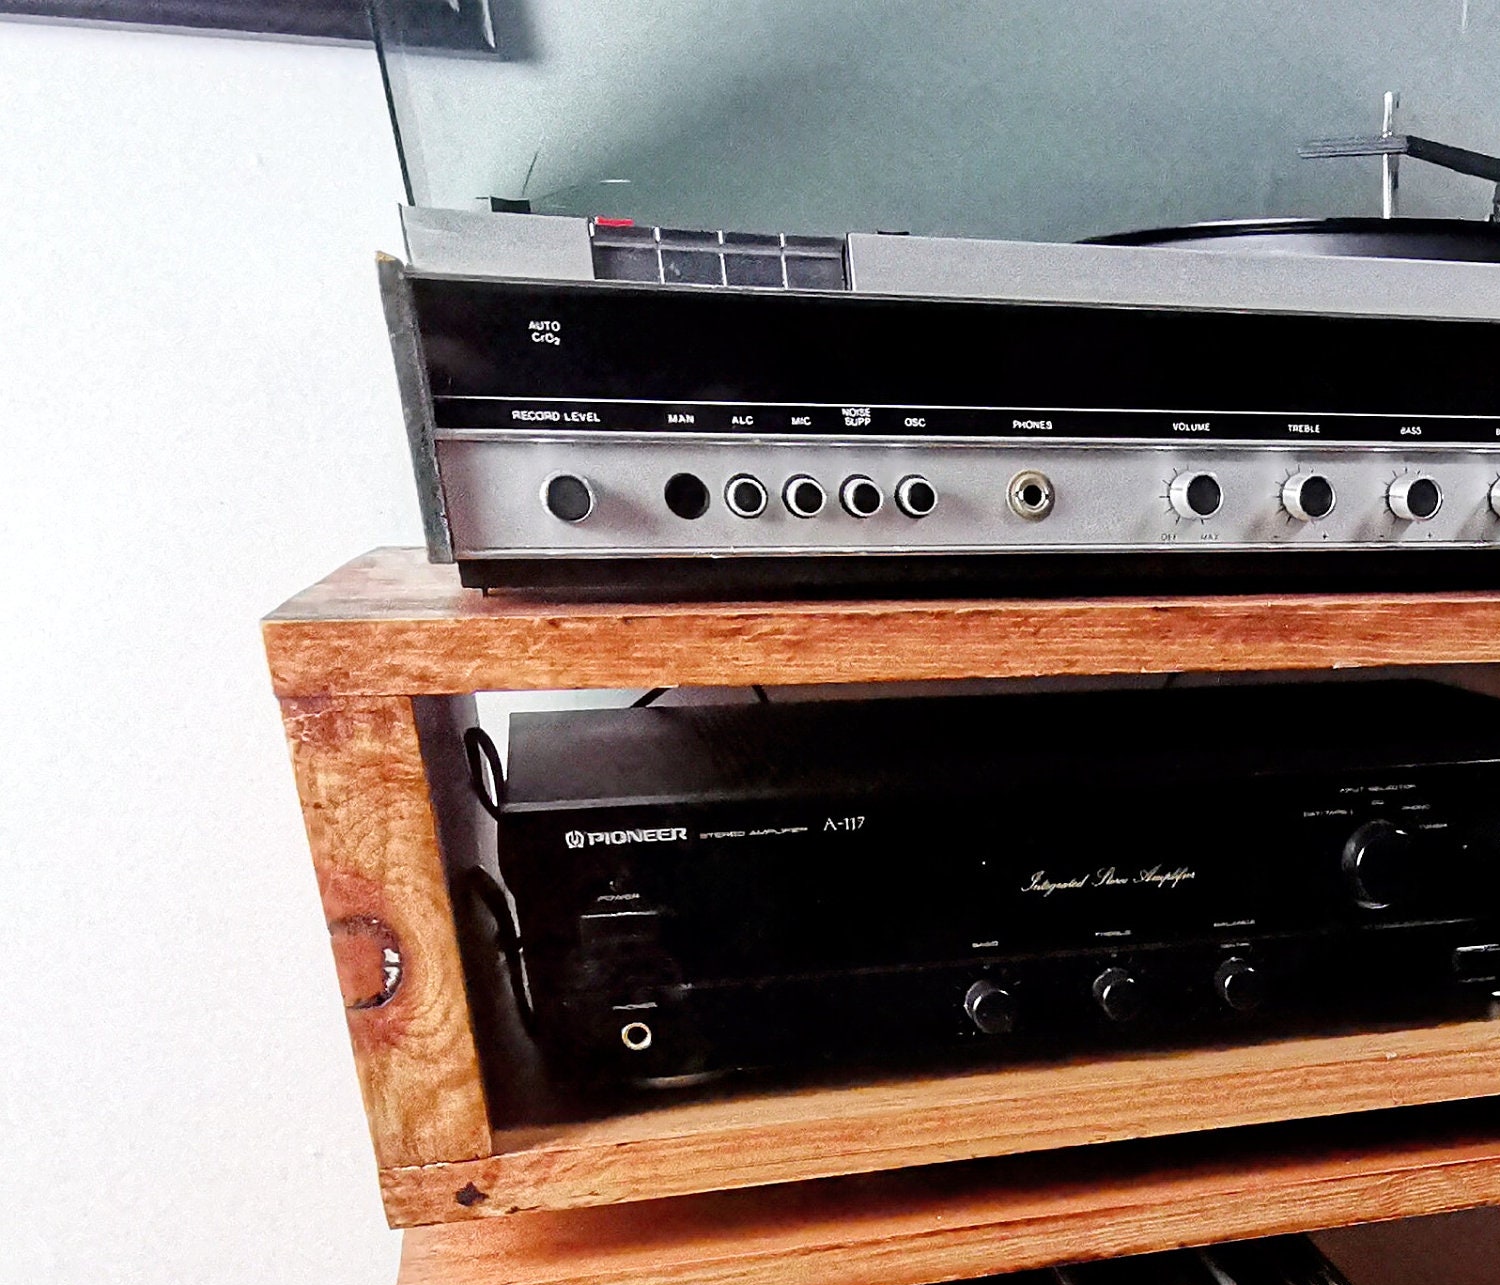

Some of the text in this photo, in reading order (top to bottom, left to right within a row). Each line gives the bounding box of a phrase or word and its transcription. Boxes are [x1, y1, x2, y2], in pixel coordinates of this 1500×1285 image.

[528, 321, 561, 332] AUTO
[512, 410, 601, 423] RECORD LEVEL
[842, 407, 871, 418] NOISE
[667, 413, 695, 424] MAN
[731, 415, 754, 426] ALC
[845, 417, 871, 427] SUPP
[904, 417, 926, 428] OSC
[1012, 419, 1053, 430] PHONES
[1172, 422, 1211, 432] VOLUME
[1288, 423, 1321, 434] TREBLE
[1400, 426, 1422, 436] BASS
[823, 816, 866, 832] A-117
[588, 827, 688, 846] PIONEER
